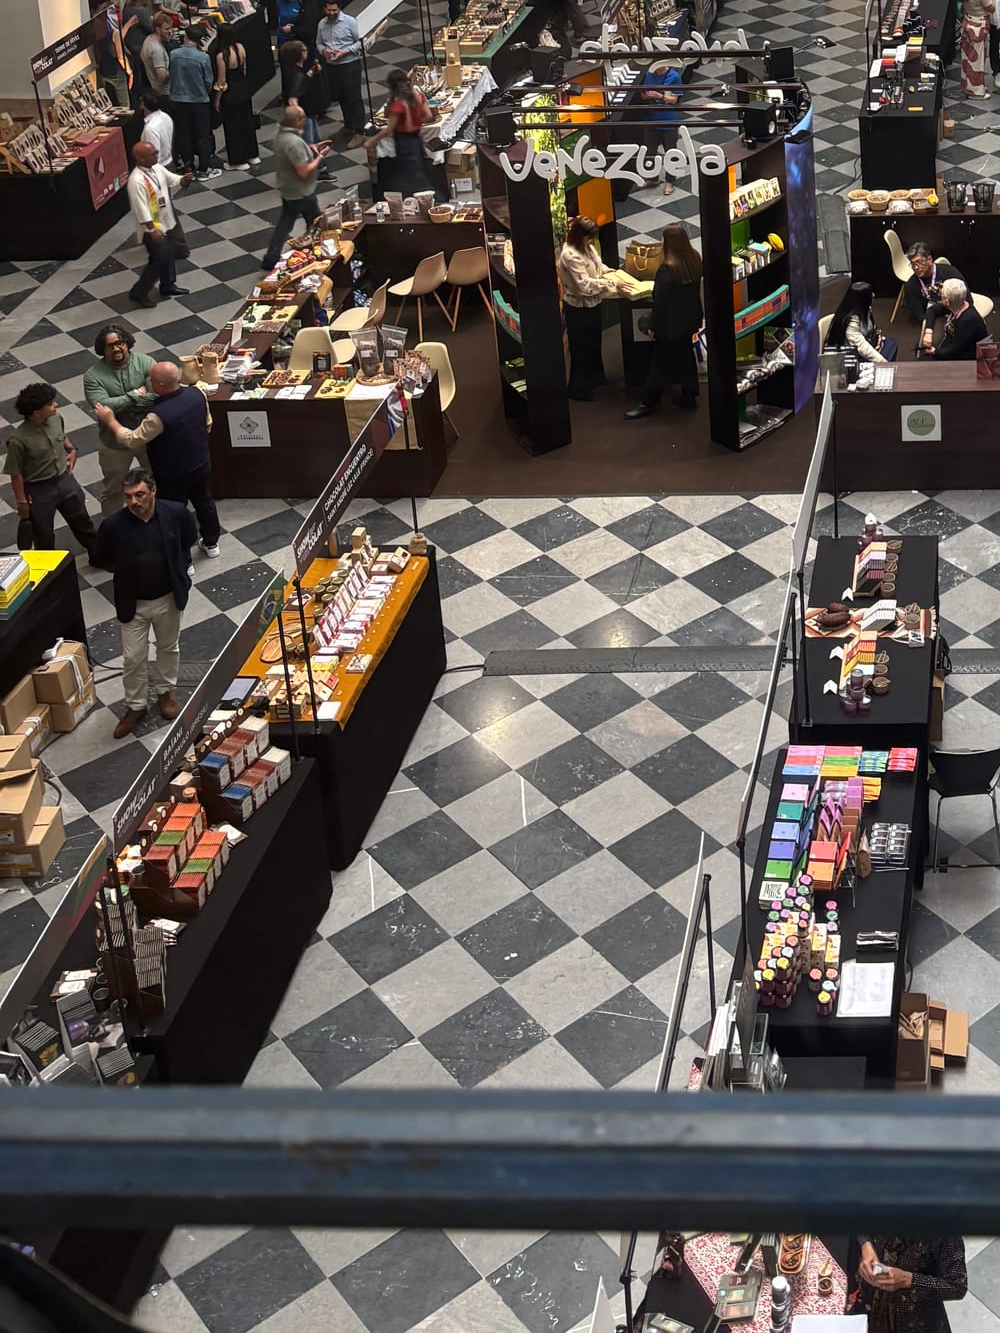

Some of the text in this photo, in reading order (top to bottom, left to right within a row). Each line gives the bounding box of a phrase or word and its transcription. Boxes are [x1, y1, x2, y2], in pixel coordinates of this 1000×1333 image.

[324, 444, 366, 511] CHOCOLAT ENCUENTRO
[307, 521, 323, 550] COLAT
[132, 778, 156, 817] COLAT
